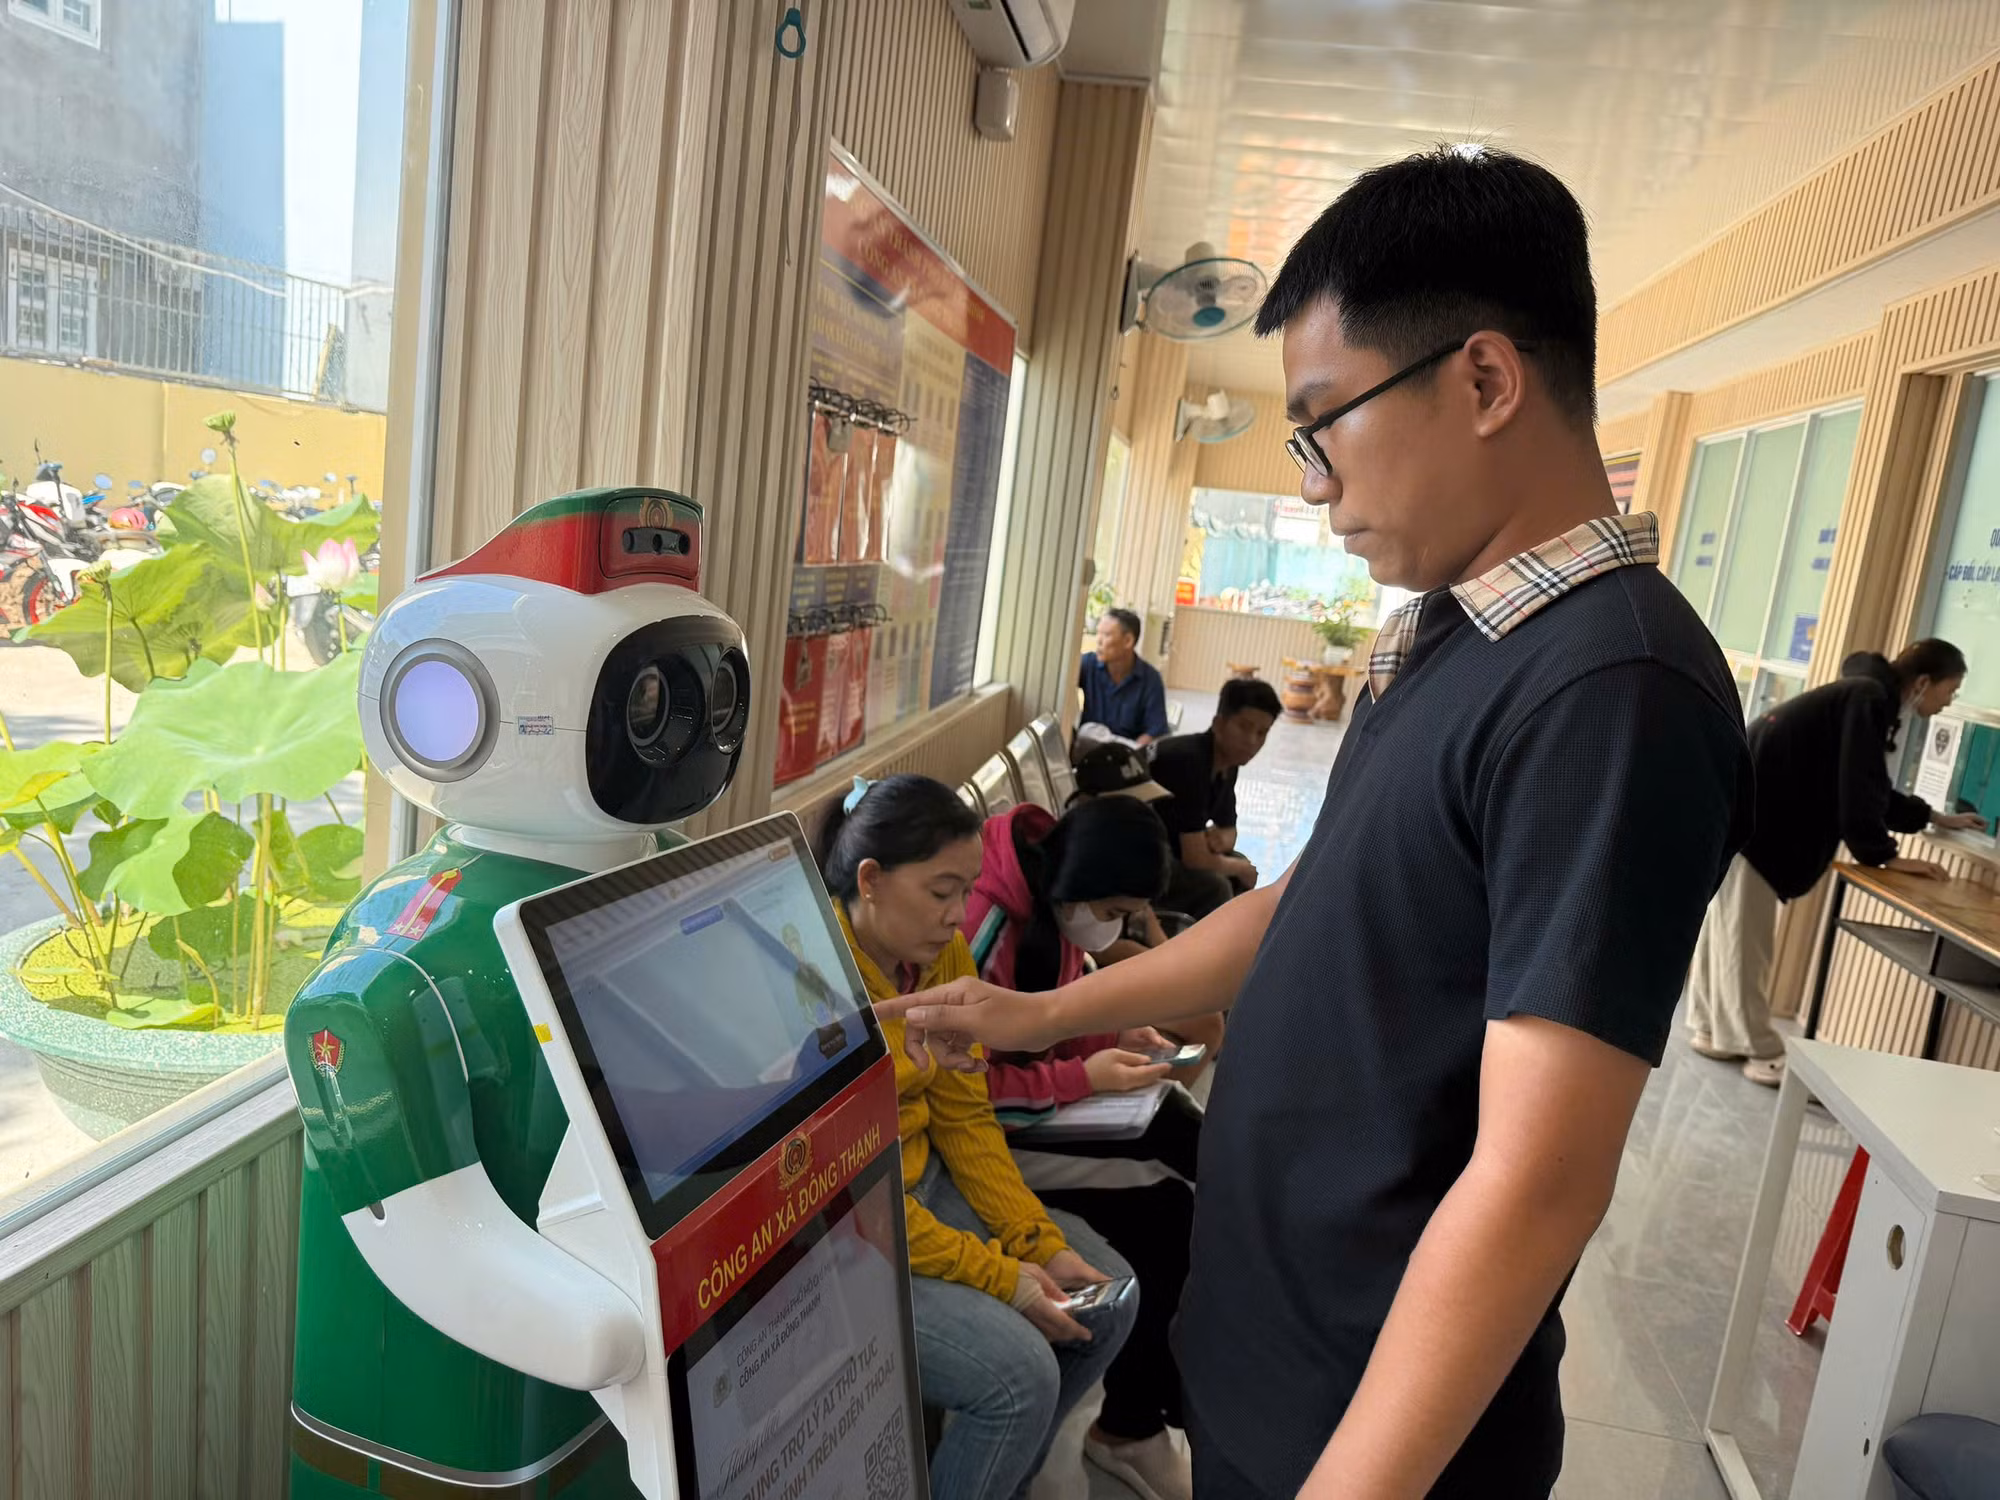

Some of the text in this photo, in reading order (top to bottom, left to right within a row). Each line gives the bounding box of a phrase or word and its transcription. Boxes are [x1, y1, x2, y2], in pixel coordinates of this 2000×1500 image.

[698, 1123, 881, 1309] CÔNG AN XÃ ĐÔNG THẠNH
[736, 1338, 758, 1367] CÔNG
[739, 1359, 760, 1388] CÔNG
[760, 1347, 771, 1367] AN
[780, 1420, 805, 1469] TRỢ
[806, 1399, 820, 1439] LÝ
[822, 1388, 835, 1421] AI
[807, 1426, 838, 1479] TRÊN
[838, 1395, 864, 1439] ĐIỆN
